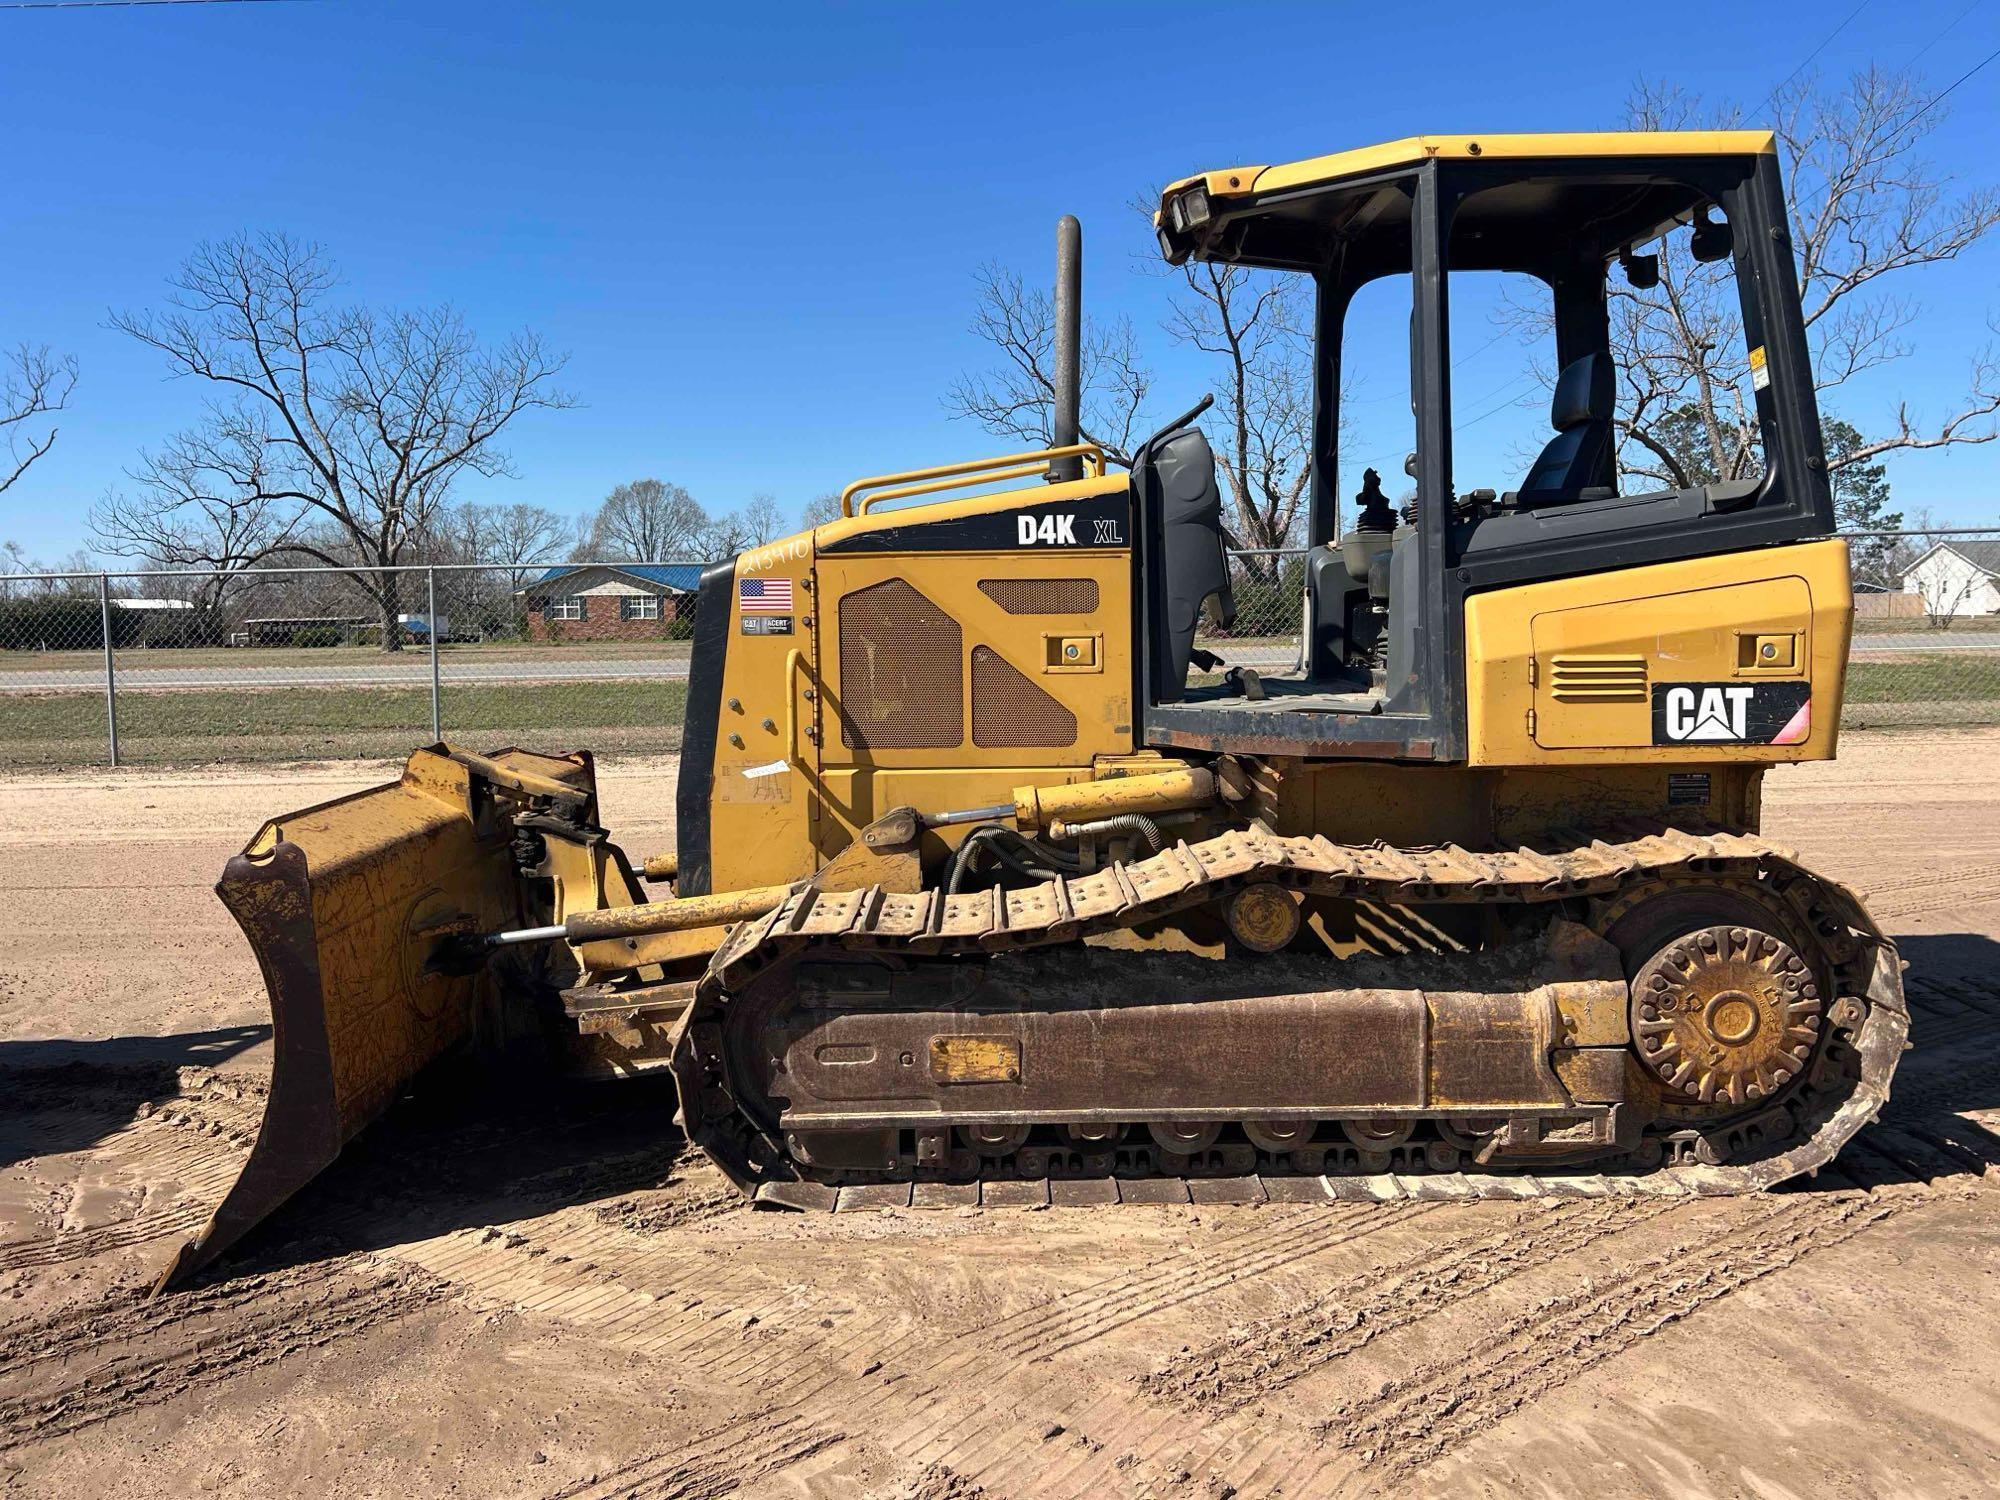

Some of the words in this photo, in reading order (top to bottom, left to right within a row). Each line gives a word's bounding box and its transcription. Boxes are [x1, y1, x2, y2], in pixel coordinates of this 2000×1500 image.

[1018, 514, 1077, 545] D4K
[1093, 519, 1123, 544] XL
[744, 619, 757, 628] CAT
[1666, 687, 1754, 740] CAT
